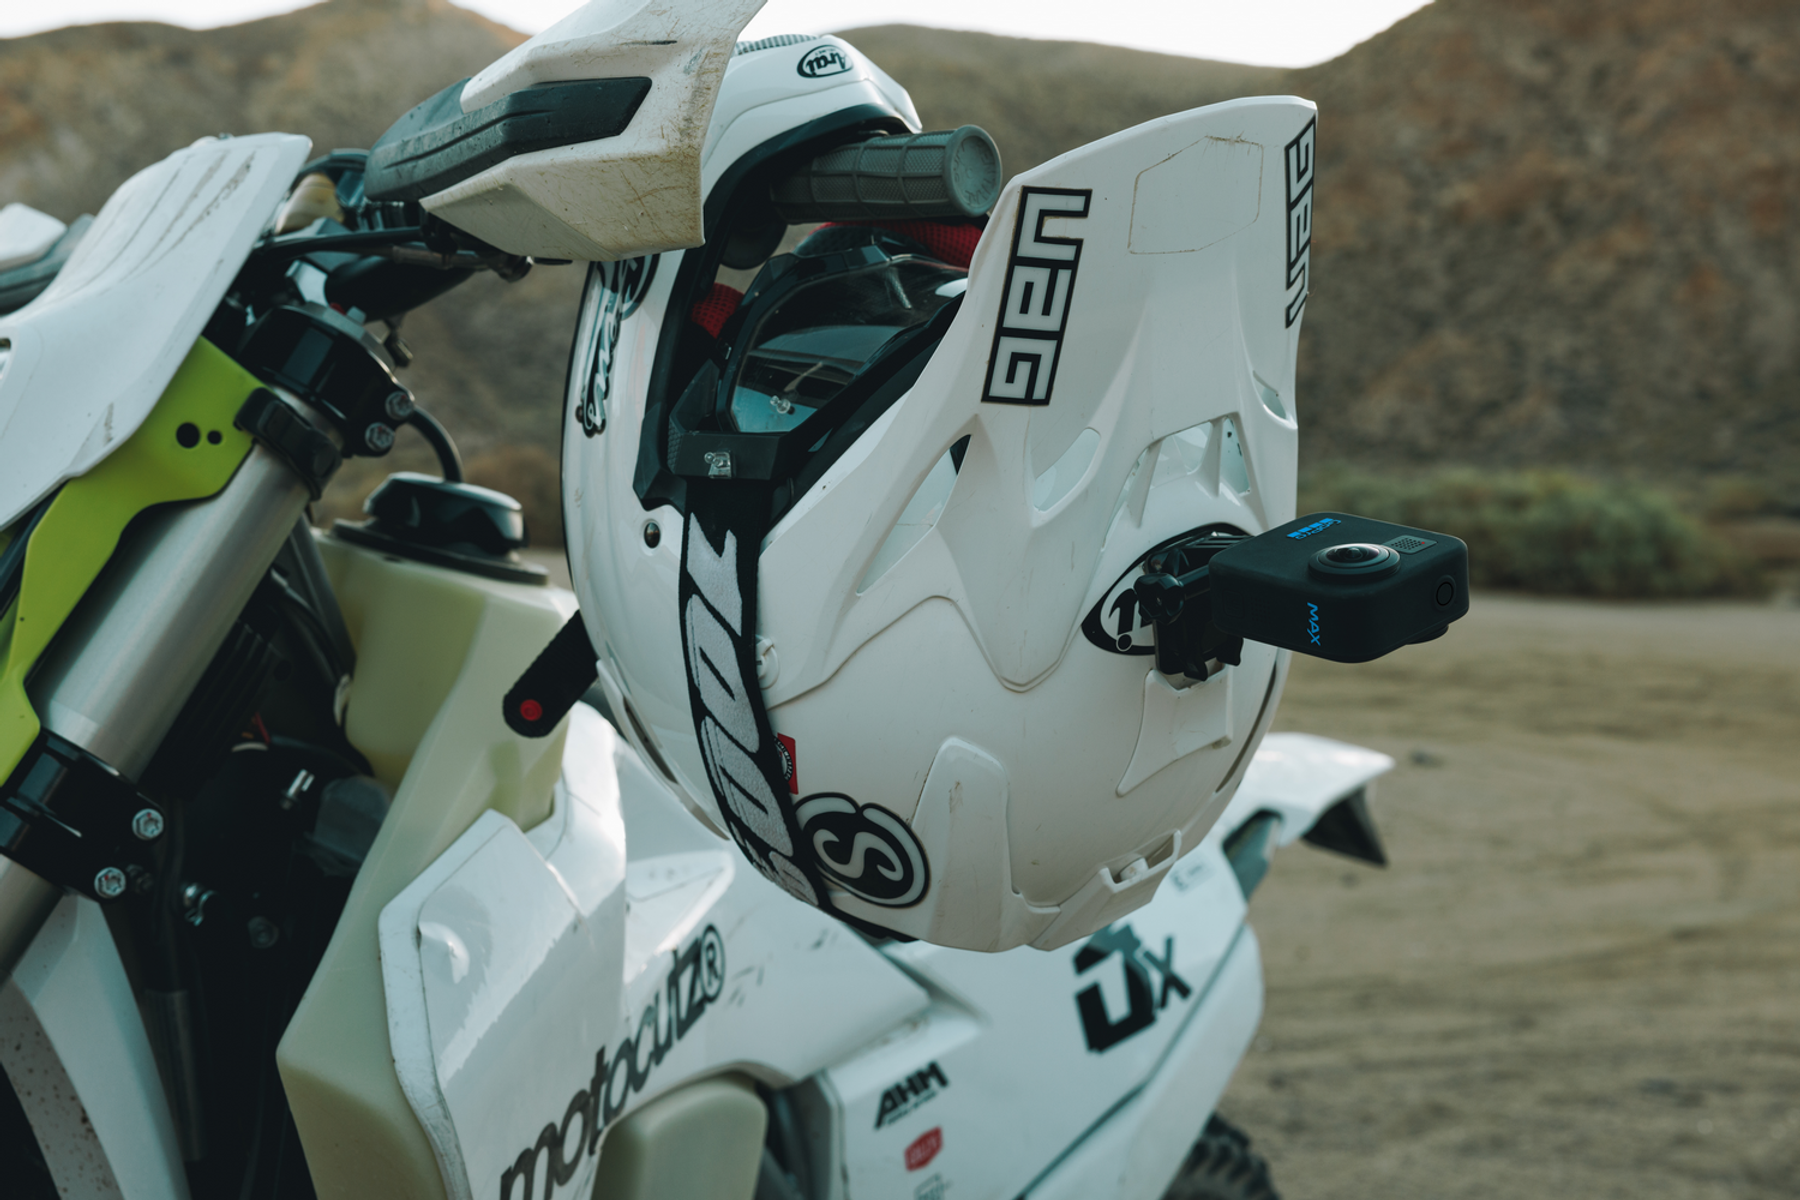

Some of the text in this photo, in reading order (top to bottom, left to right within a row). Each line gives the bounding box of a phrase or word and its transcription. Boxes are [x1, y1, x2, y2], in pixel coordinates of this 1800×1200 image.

[805, 52, 847, 77] Arai
[1291, 518, 1343, 541] GoPro
[1306, 601, 1322, 647] MAX
[873, 1060, 949, 1132] AHM
